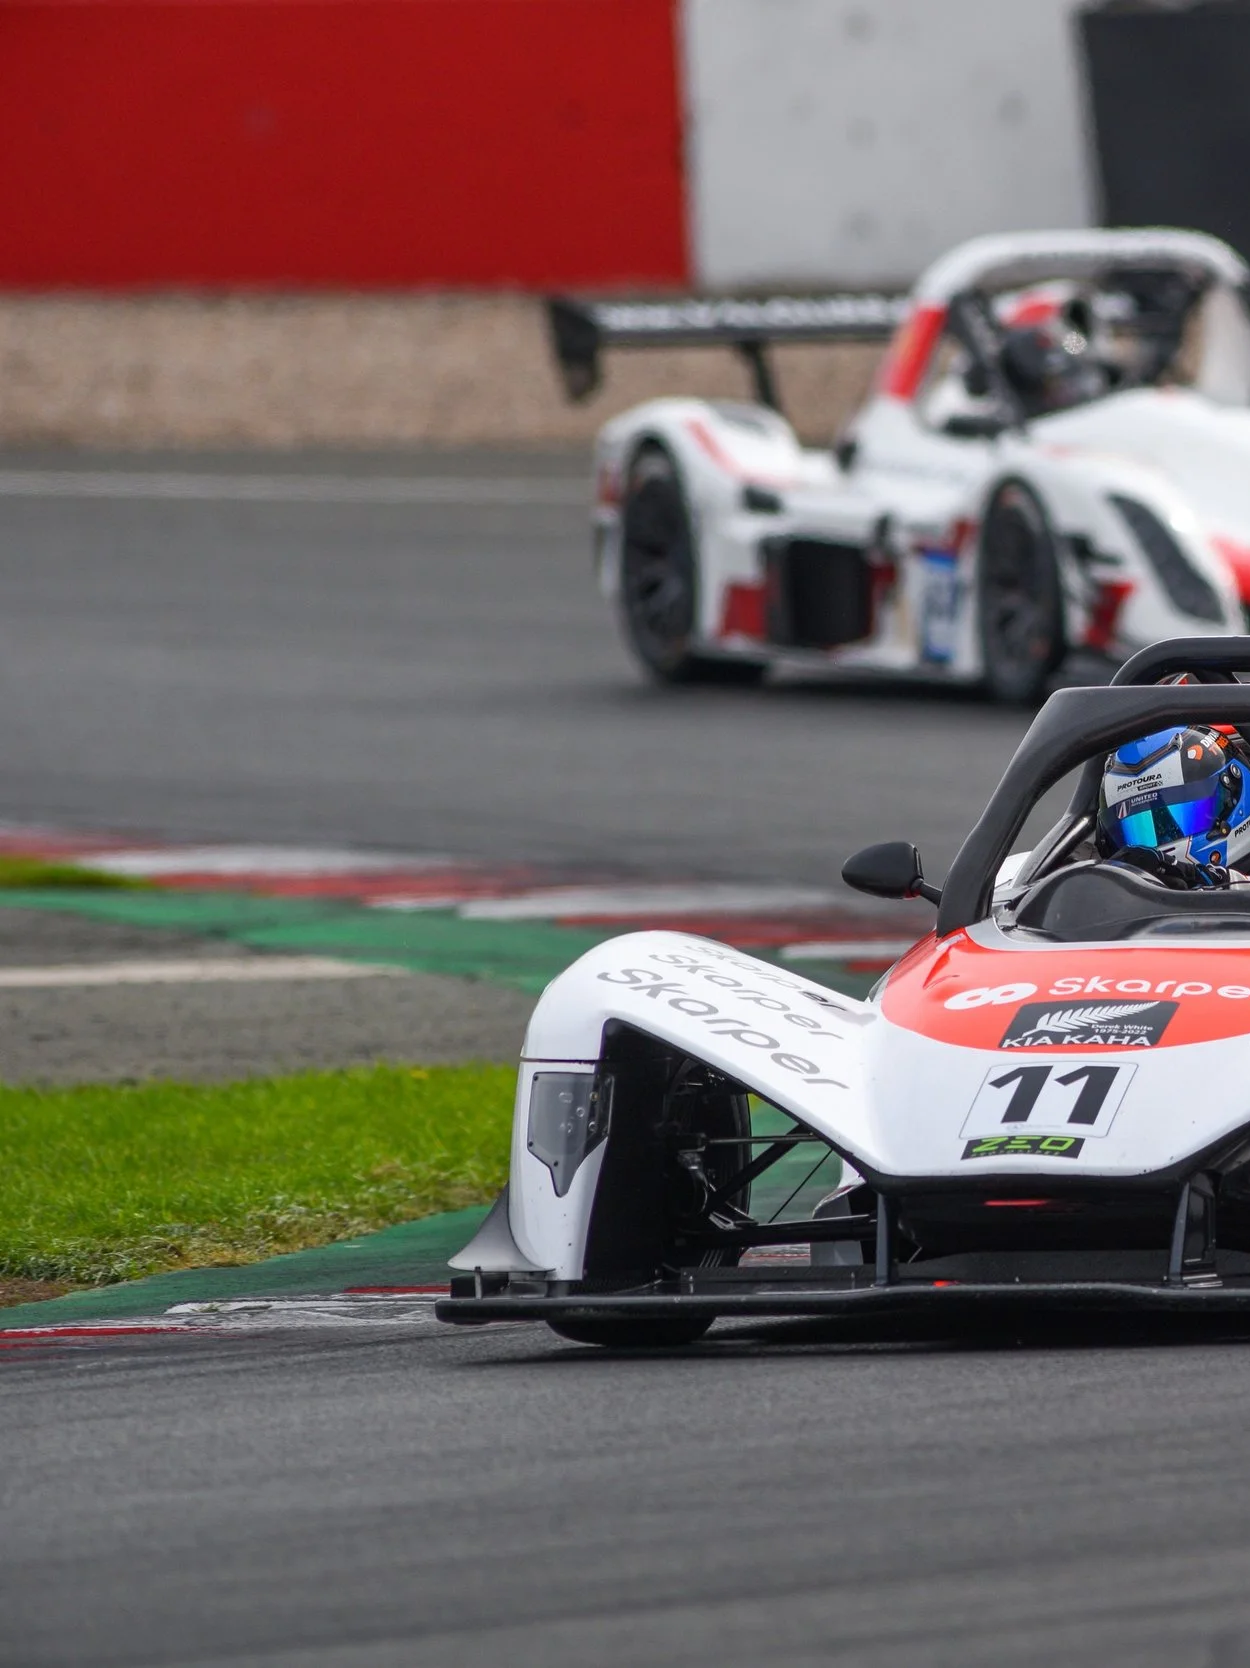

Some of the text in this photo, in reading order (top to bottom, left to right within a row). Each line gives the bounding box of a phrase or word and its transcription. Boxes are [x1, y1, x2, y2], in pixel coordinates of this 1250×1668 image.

[1117, 773, 1162, 791] PROTOURA
[1130, 792, 1158, 803] UNITED
[649, 952, 845, 1040] Skarper
[596, 967, 850, 1089] Skarper
[1001, 1034, 1152, 1048] KIA KAHA
[988, 1064, 1121, 1126] 11
